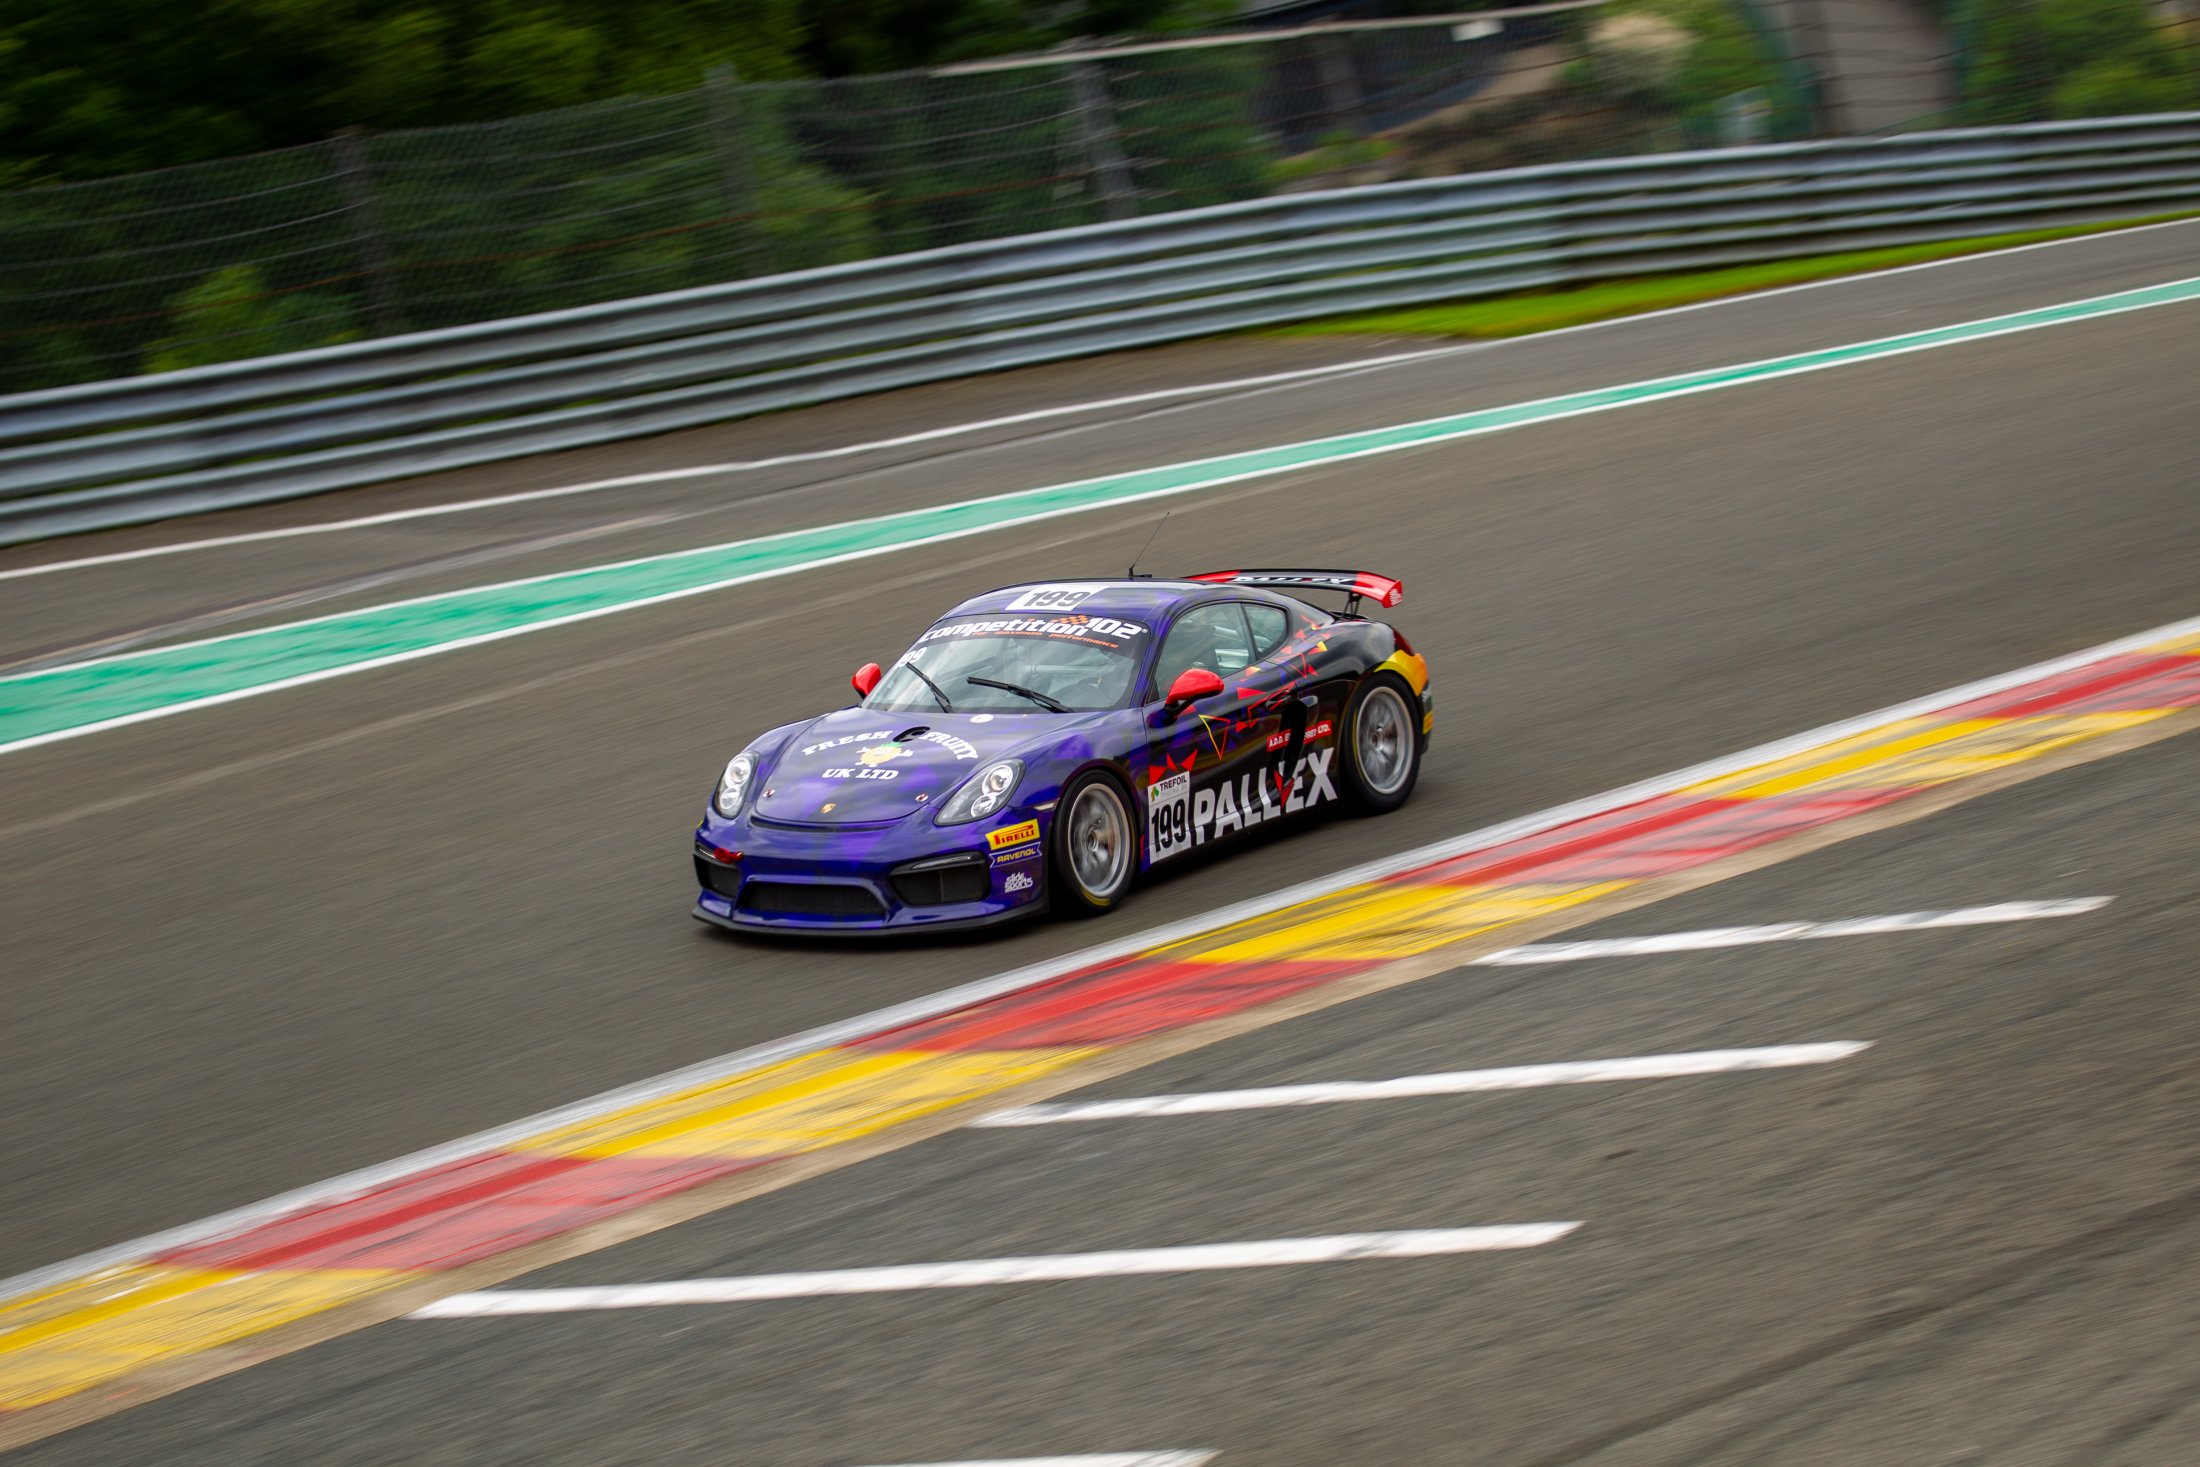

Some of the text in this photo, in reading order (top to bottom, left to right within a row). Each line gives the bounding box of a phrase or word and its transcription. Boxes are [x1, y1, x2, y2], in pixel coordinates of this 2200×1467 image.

[1022, 591, 1091, 607] 199
[1047, 632, 1119, 649] performance
[802, 730, 979, 760] FRESH FRUITY
[821, 768, 899, 780] UK LTD
[1159, 774, 1188, 792] TREFOIL
[1151, 798, 1187, 853] 199
[993, 824, 1035, 846] PIRELLI
[996, 848, 1037, 863] RAVENOL
